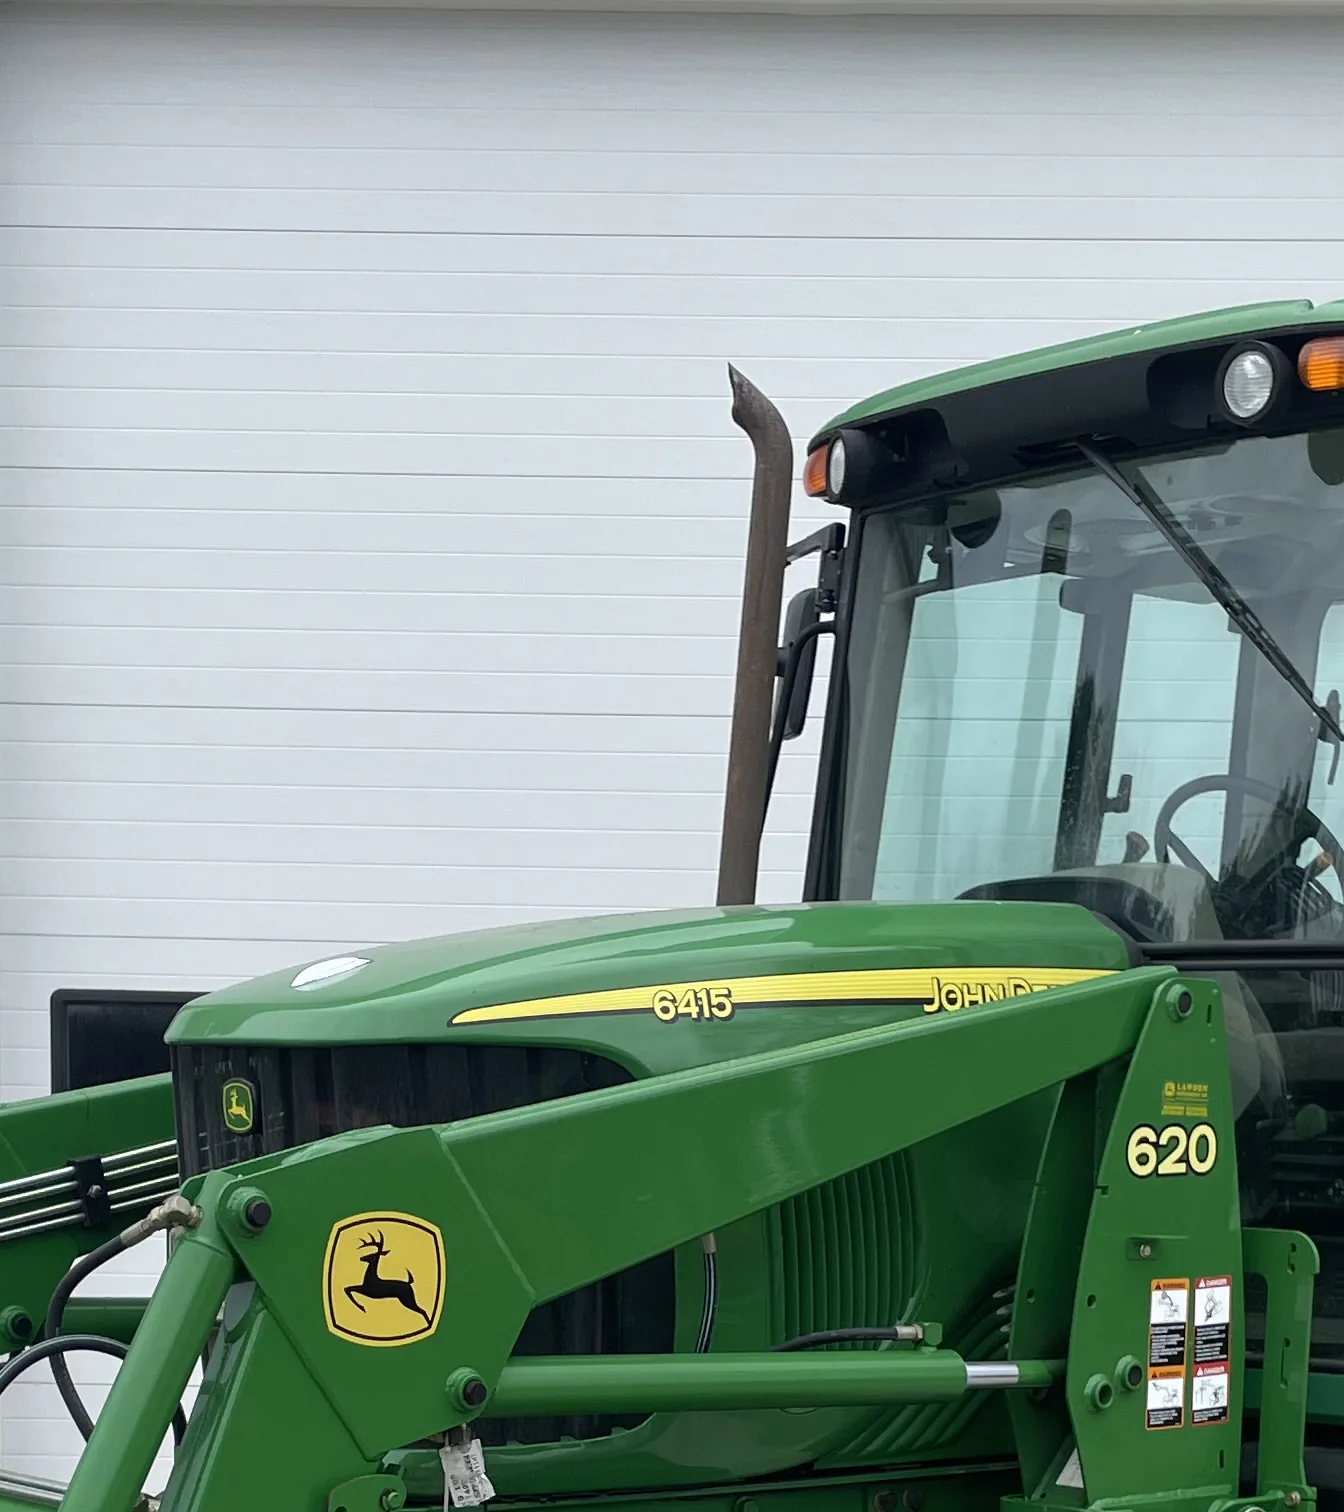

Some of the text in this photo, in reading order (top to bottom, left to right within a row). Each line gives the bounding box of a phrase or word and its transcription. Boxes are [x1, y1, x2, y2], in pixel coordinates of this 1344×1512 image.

[653, 988, 734, 1023] 6415
[923, 977, 1006, 1013] JOHN
[1126, 1123, 1217, 1178] 620
